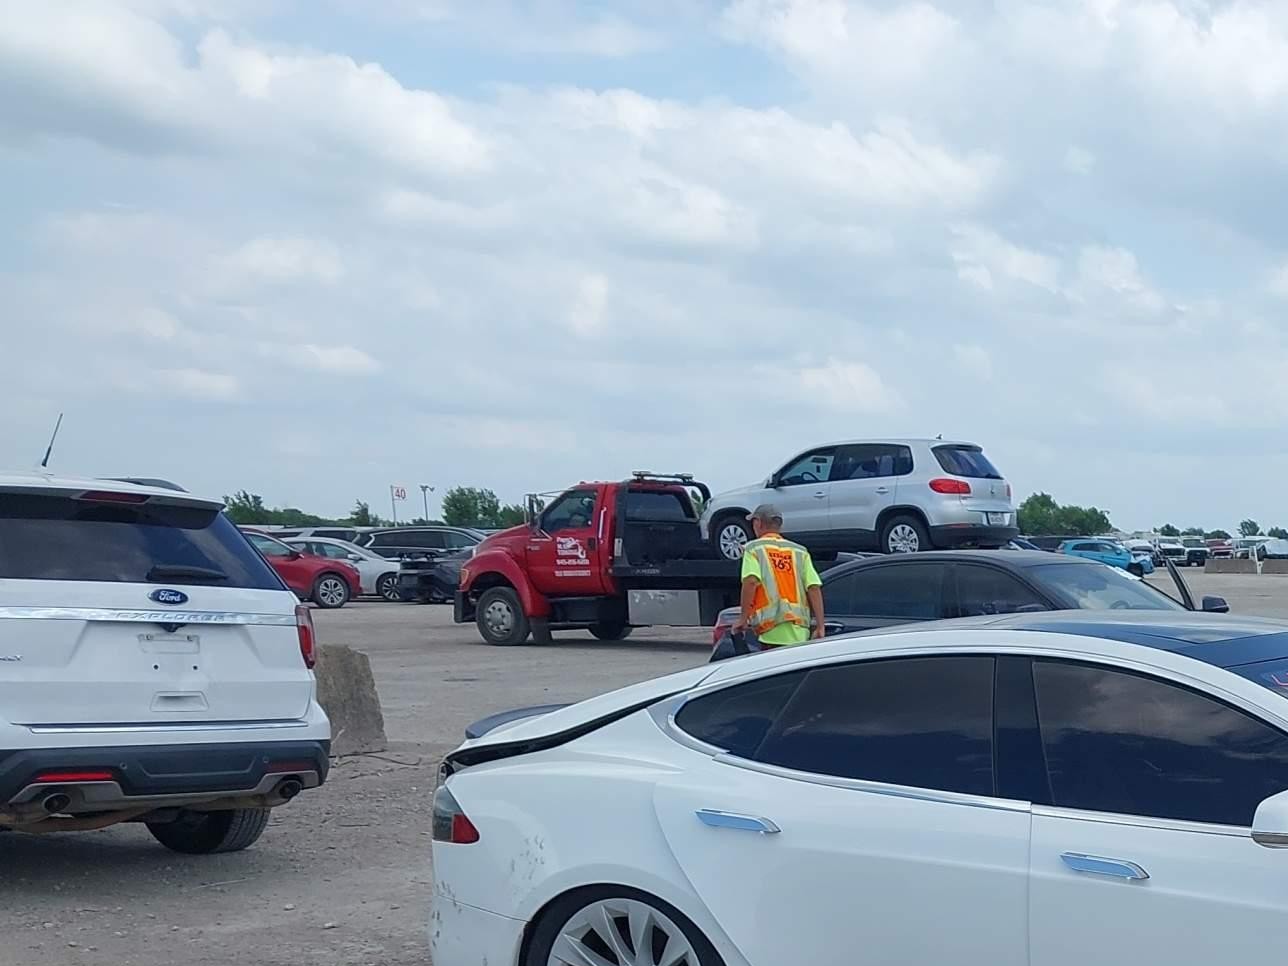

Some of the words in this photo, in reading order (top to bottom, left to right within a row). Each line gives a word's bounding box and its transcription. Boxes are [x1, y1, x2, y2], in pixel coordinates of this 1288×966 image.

[395, 488, 407, 500] 40
[158, 590, 181, 602] Ford
[116, 611, 225, 622] EXPLORER
